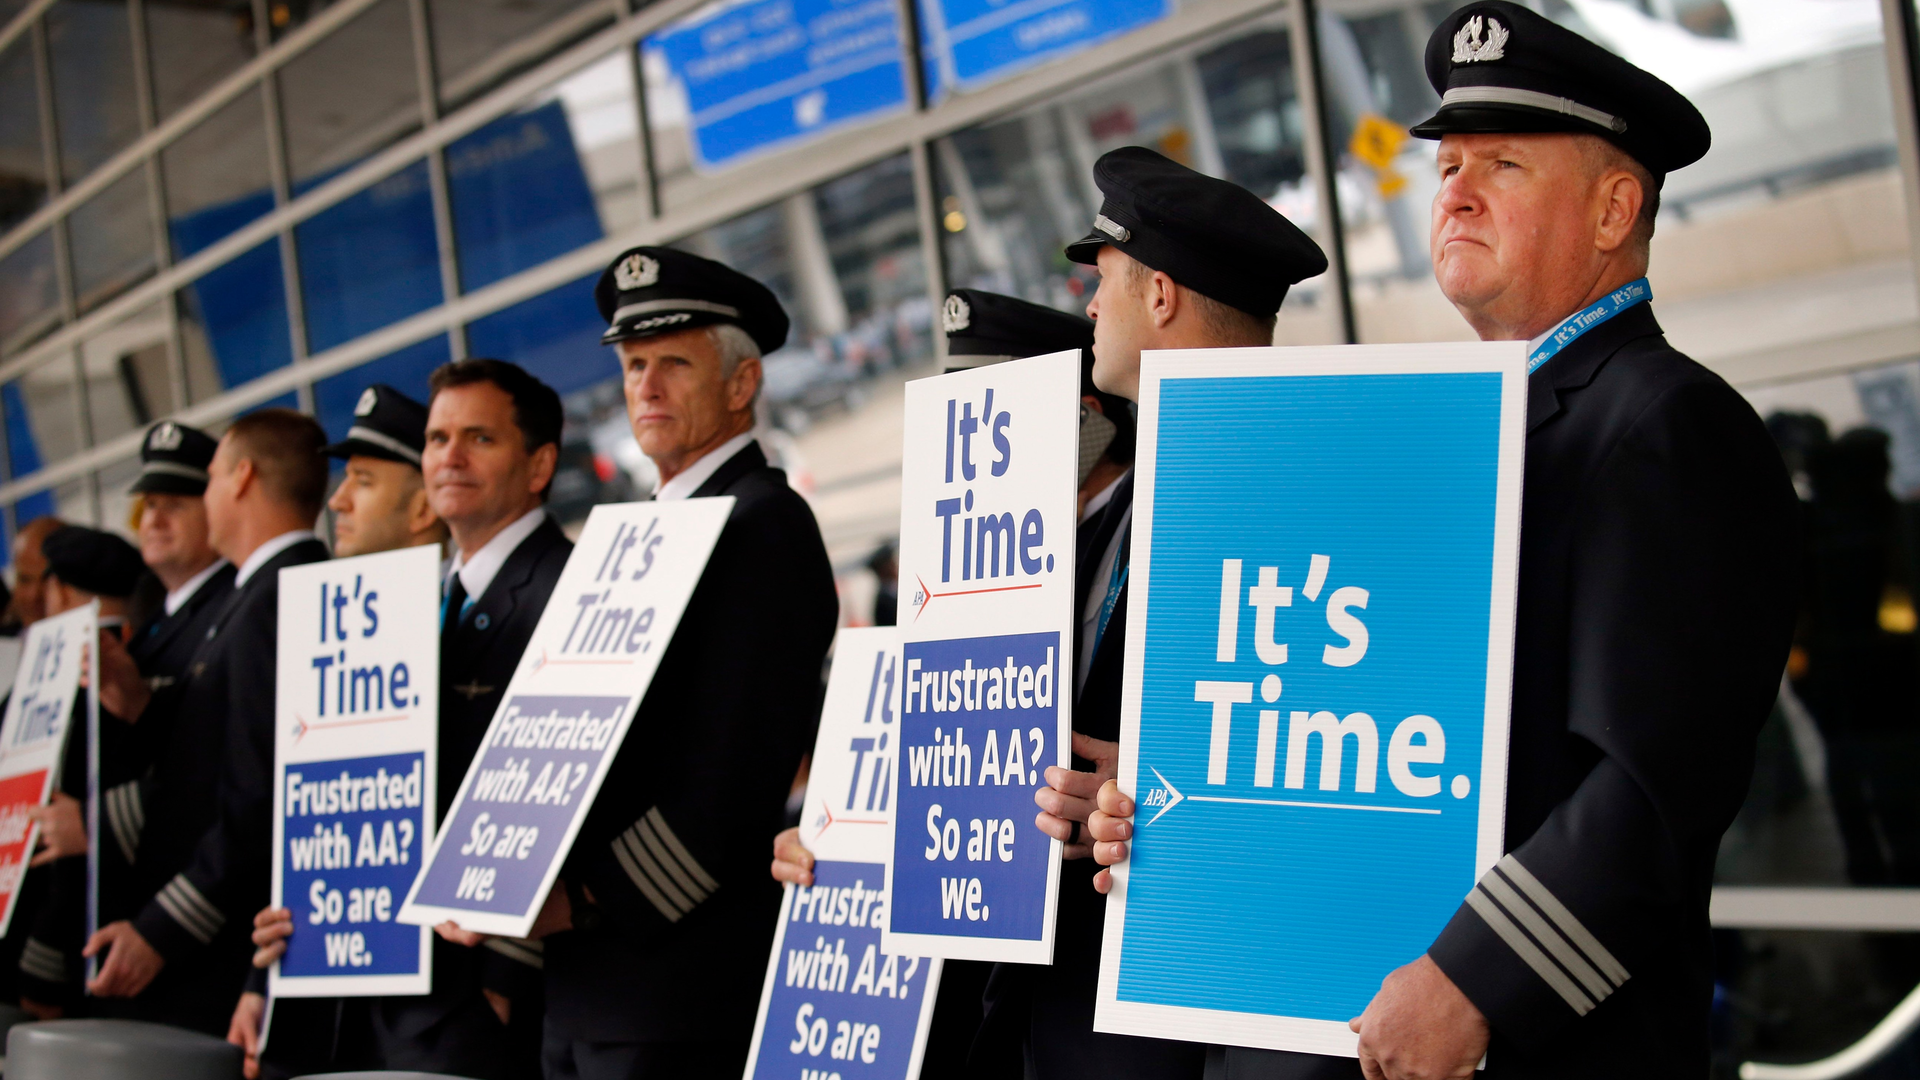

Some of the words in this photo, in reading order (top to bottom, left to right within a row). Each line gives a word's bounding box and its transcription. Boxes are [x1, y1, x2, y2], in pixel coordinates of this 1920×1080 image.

[1554, 326, 1577, 345] It's
[1573, 306, 1608, 328] Time.
[1611, 290, 1631, 306] It's
[1528, 350, 1550, 369] me.
[945, 387, 1011, 484] It's
[595, 517, 663, 582] It's
[936, 488, 1055, 582] Time.
[320, 574, 378, 643] It's
[560, 588, 656, 654] Time.
[1216, 553, 1369, 667] It's
[312, 649, 419, 716] Time.
[863, 651, 895, 724] It
[905, 646, 1054, 714] Frustrated
[492, 705, 626, 751] Frustrated
[908, 727, 971, 787] with
[978, 727, 1044, 787] AA?
[1194, 674, 1471, 799] Time.
[286, 759, 421, 817] Frustrated
[472, 757, 529, 802] with
[524, 762, 587, 806] AA?
[1143, 789, 1168, 807] APA
[290, 822, 350, 871] with
[355, 820, 414, 868] AA?
[461, 812, 492, 857] So
[494, 824, 538, 860] are
[925, 804, 960, 862] So
[967, 817, 1015, 862] are
[309, 880, 343, 925] So
[349, 887, 391, 922] are
[456, 866, 494, 901] we.
[791, 879, 884, 929] Frustra
[941, 876, 990, 921] we.
[326, 931, 372, 967] we.
[786, 935, 849, 993] with
[851, 944, 919, 999] AA?
[790, 1002, 828, 1056] So
[830, 1020, 880, 1064] are
